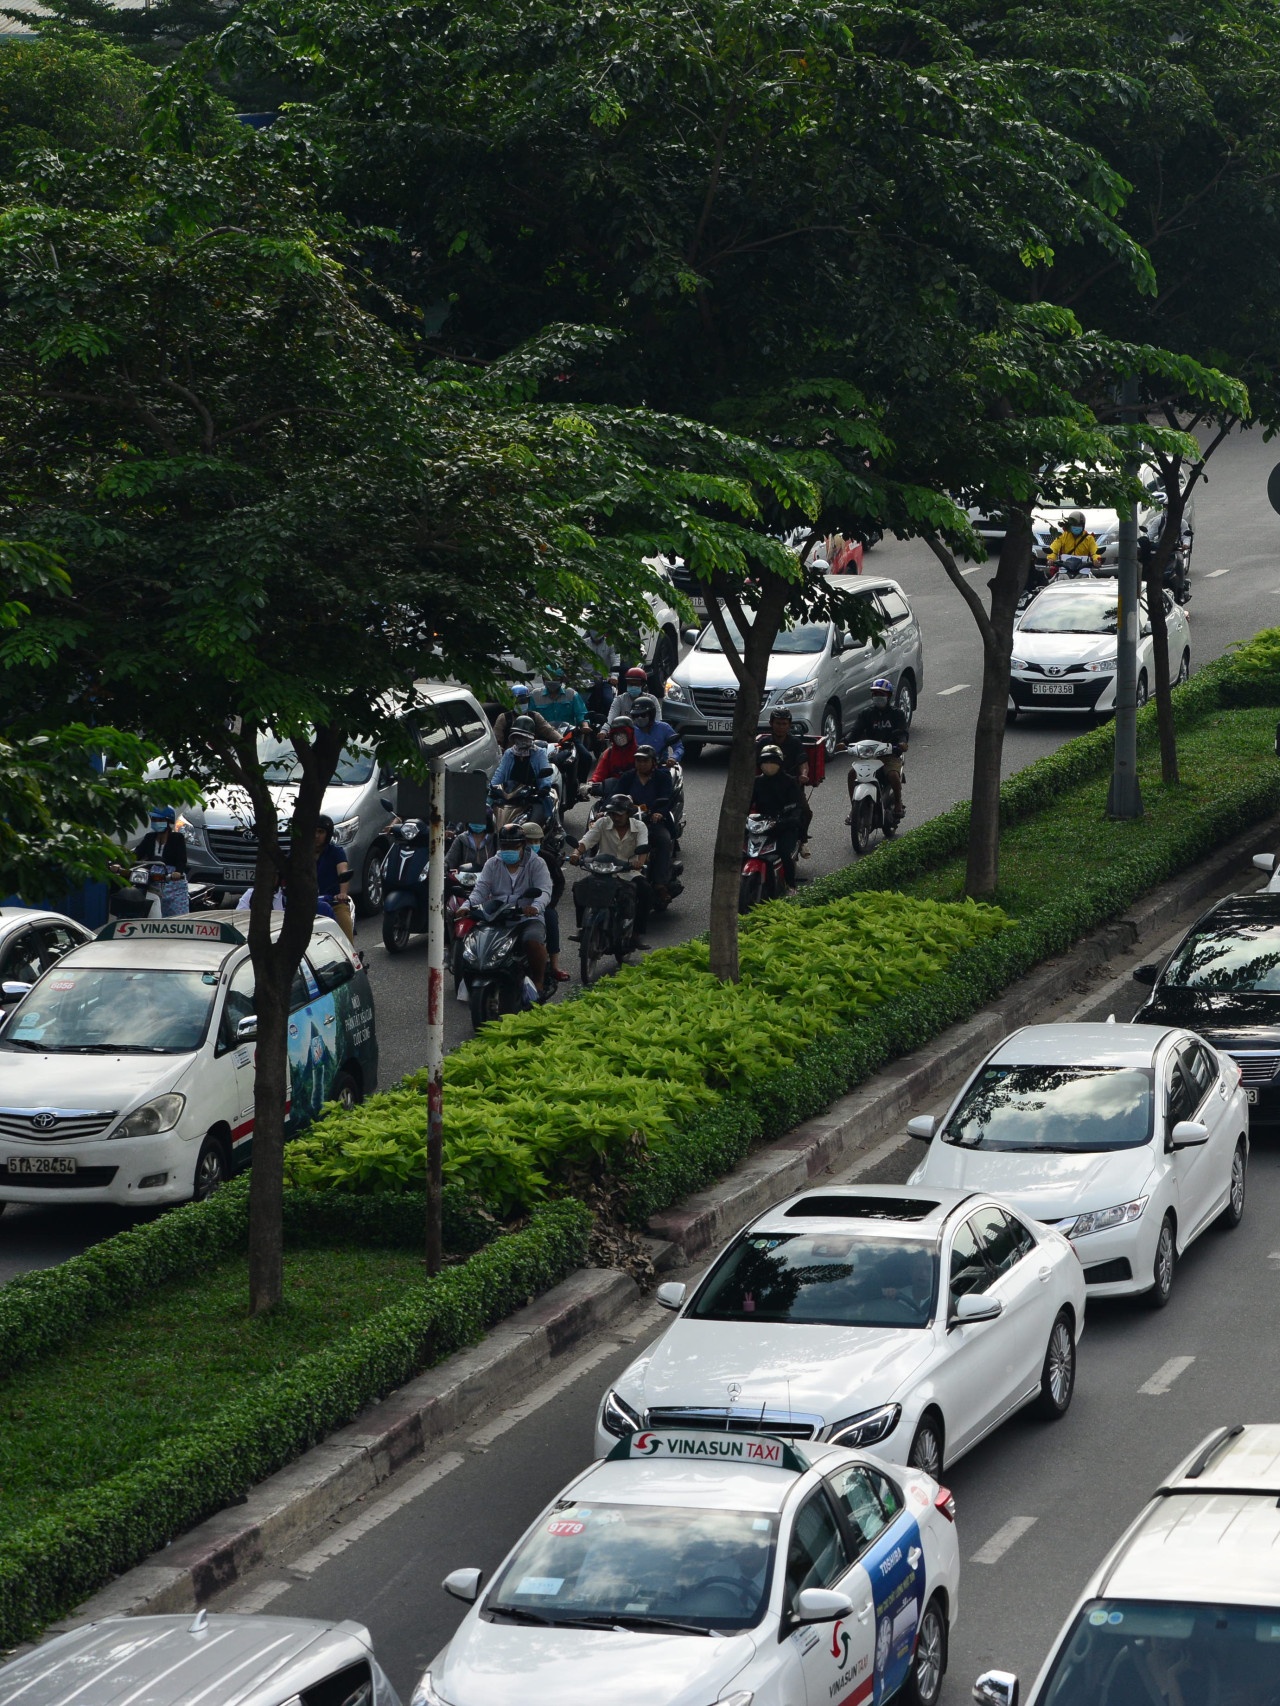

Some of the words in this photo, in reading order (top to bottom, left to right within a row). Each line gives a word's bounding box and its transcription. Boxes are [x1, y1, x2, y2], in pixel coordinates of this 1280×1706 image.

[140, 923, 194, 935] VINASUN
[195, 924, 220, 936] TAXI
[666, 1438, 744, 1457] VINASUN
[746, 1442, 780, 1461] TAXI
[548, 1523, 584, 1534] 9779
[880, 1546, 903, 1575] TOSHIBA
